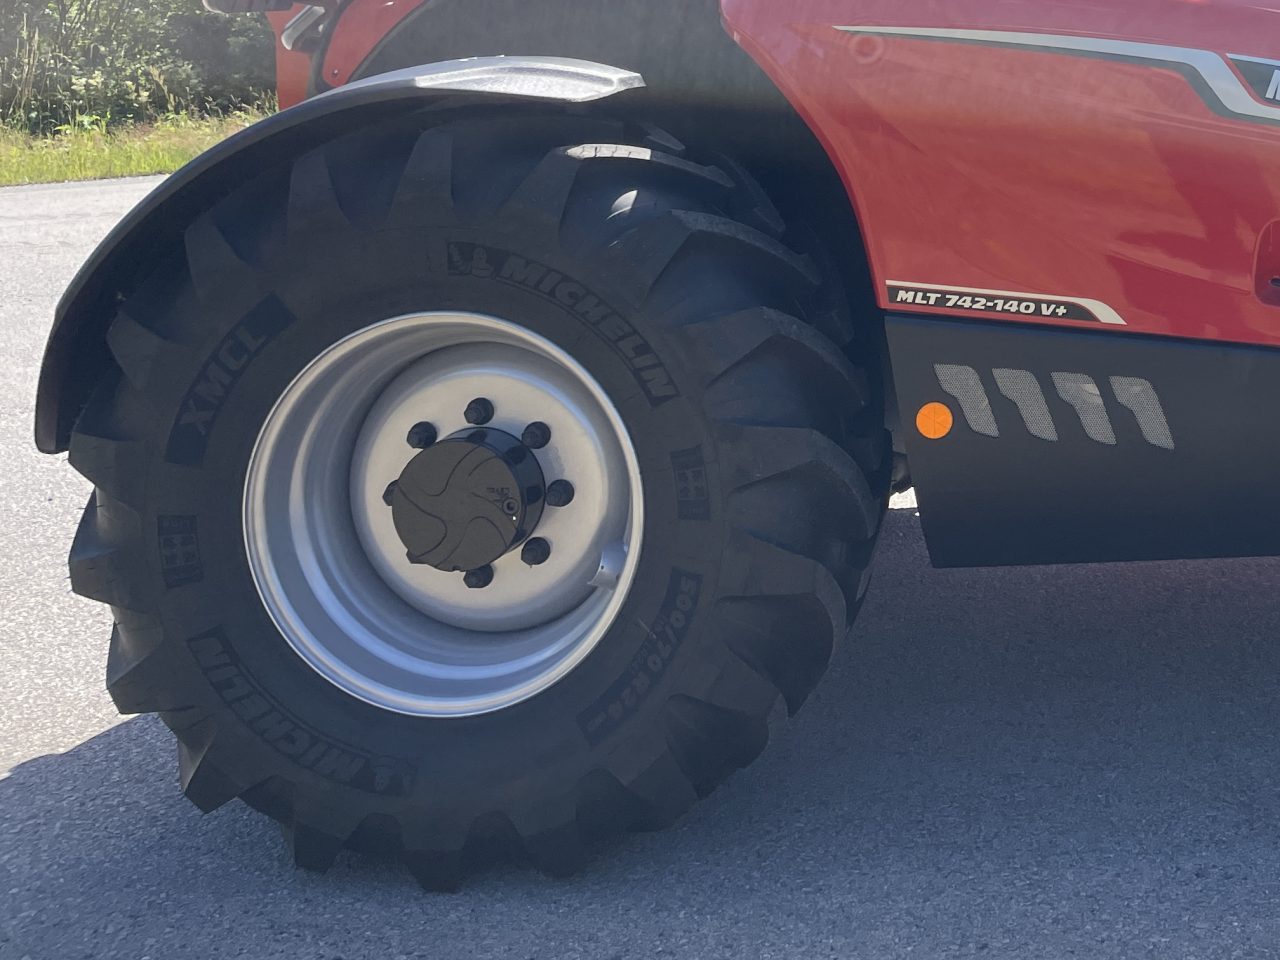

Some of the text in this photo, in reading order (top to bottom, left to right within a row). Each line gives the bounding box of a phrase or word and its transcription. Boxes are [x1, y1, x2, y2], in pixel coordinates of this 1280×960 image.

[499, 253, 678, 398] MICHELIN
[896, 290, 1067, 316] MLT 742-140 V+
